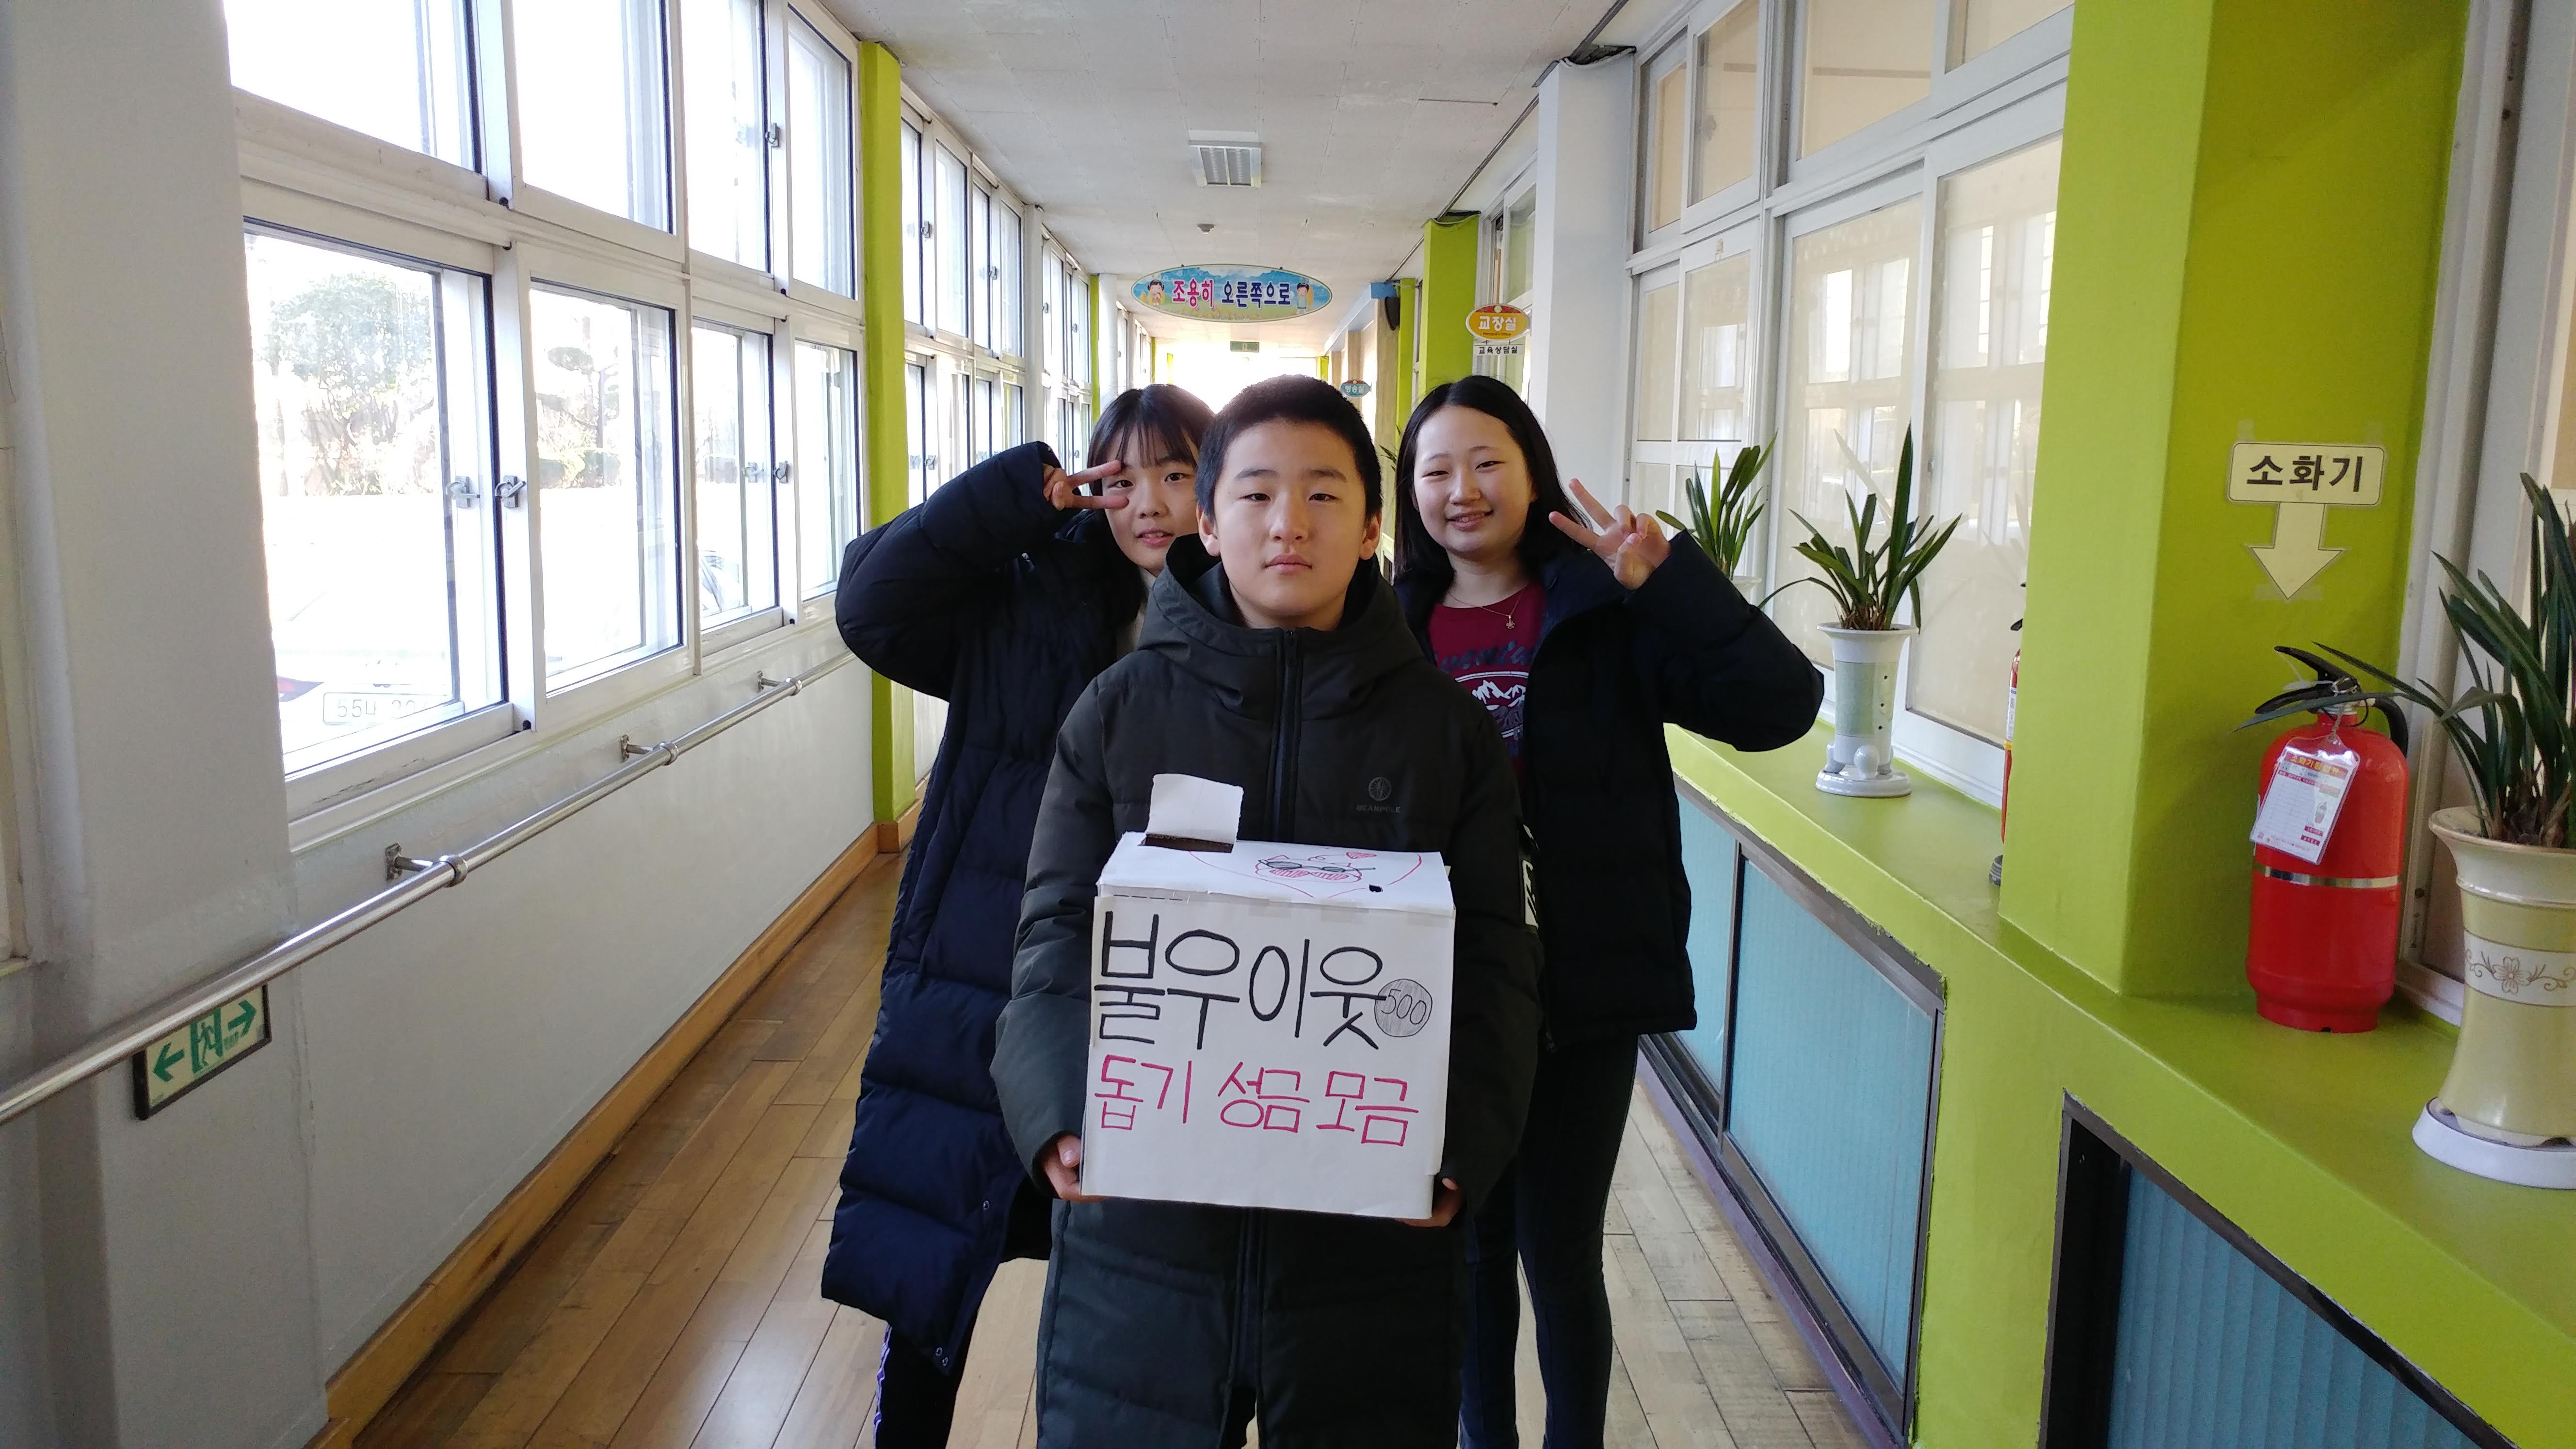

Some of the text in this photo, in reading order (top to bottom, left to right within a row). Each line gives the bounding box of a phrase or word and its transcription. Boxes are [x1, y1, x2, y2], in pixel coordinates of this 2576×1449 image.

[1173, 279, 1291, 308] 조용히 오른쪽으로
[1478, 316, 1516, 331] 교장실
[2246, 455, 2363, 492] 소화기
[1094, 910, 1387, 1050] 불우이웃
[1380, 988, 1427, 1026] 500
[1095, 1055, 1419, 1146] 돕기 성금 모금
